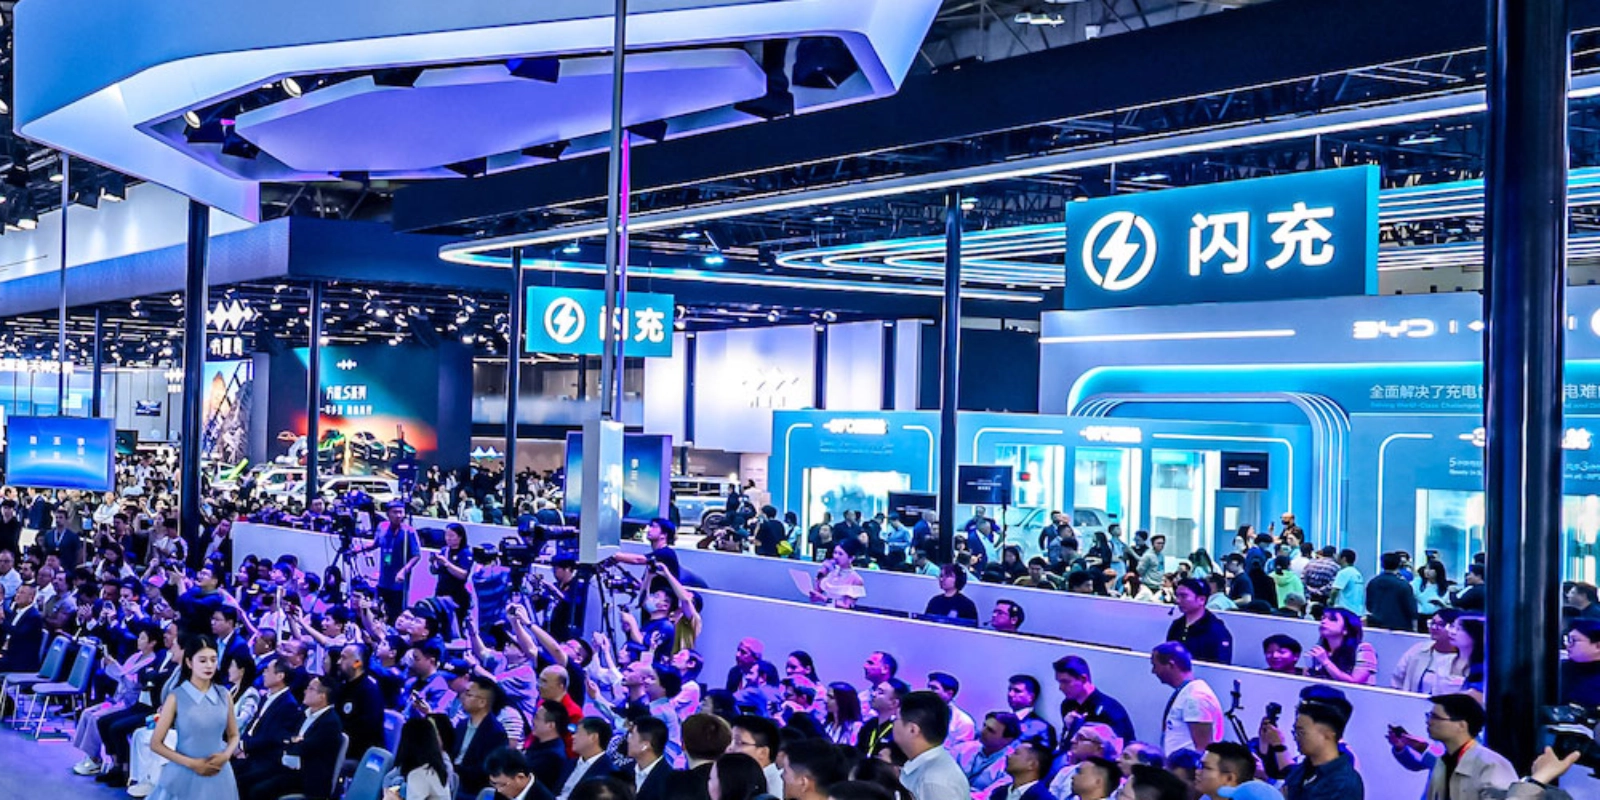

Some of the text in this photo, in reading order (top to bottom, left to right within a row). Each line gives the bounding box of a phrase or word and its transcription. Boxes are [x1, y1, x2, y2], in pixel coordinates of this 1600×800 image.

[1188, 201, 1335, 277] 闪充
[599, 305, 665, 342] 闪充
[1352, 318, 1435, 340] BYD
